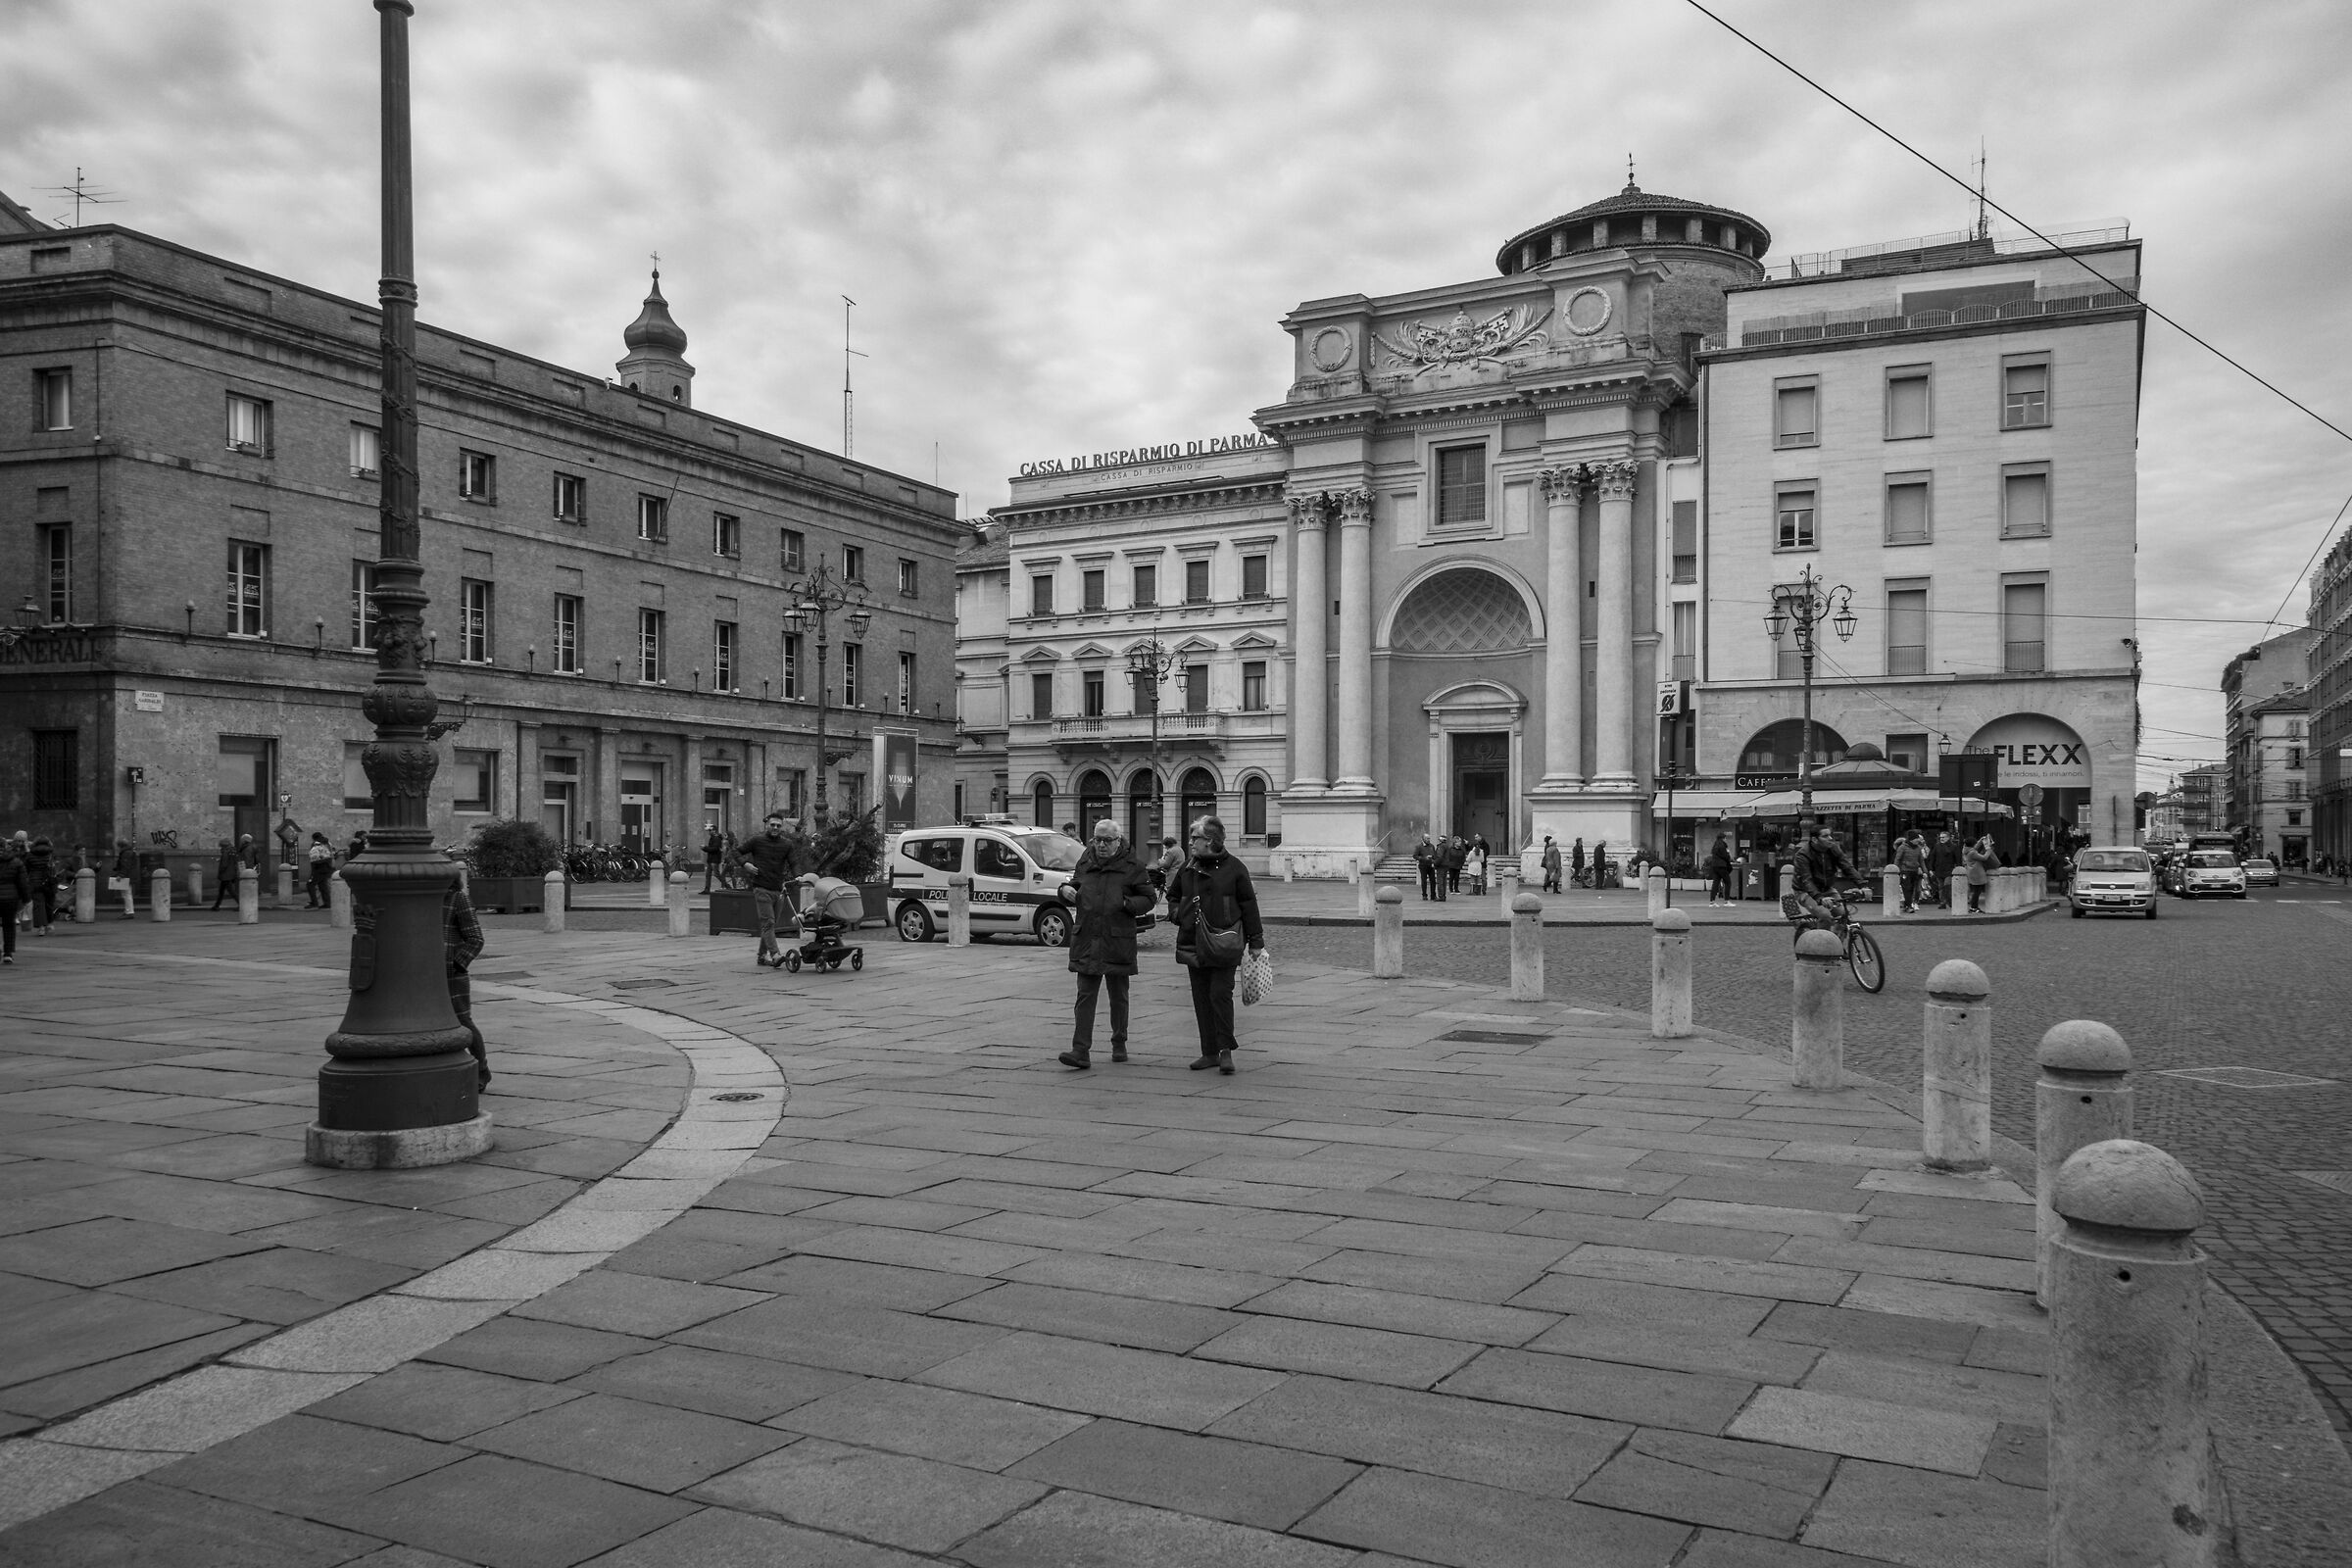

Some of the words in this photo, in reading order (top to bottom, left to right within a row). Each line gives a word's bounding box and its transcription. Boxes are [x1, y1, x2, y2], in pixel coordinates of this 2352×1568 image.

[1020, 460, 1064, 477] CASSA
[1071, 456, 1088, 471] DI
[1093, 443, 1181, 468] RISPARMIO
[1186, 439, 1204, 456] DI
[1209, 432, 1269, 454] PARMA
[1101, 471, 1128, 481] CASSA
[1148, 463, 1193, 475] RISPARMIO
[1993, 744, 2082, 765] FLEXX
[928, 890, 949, 900] POLI
[973, 892, 1008, 903] LOCALE
